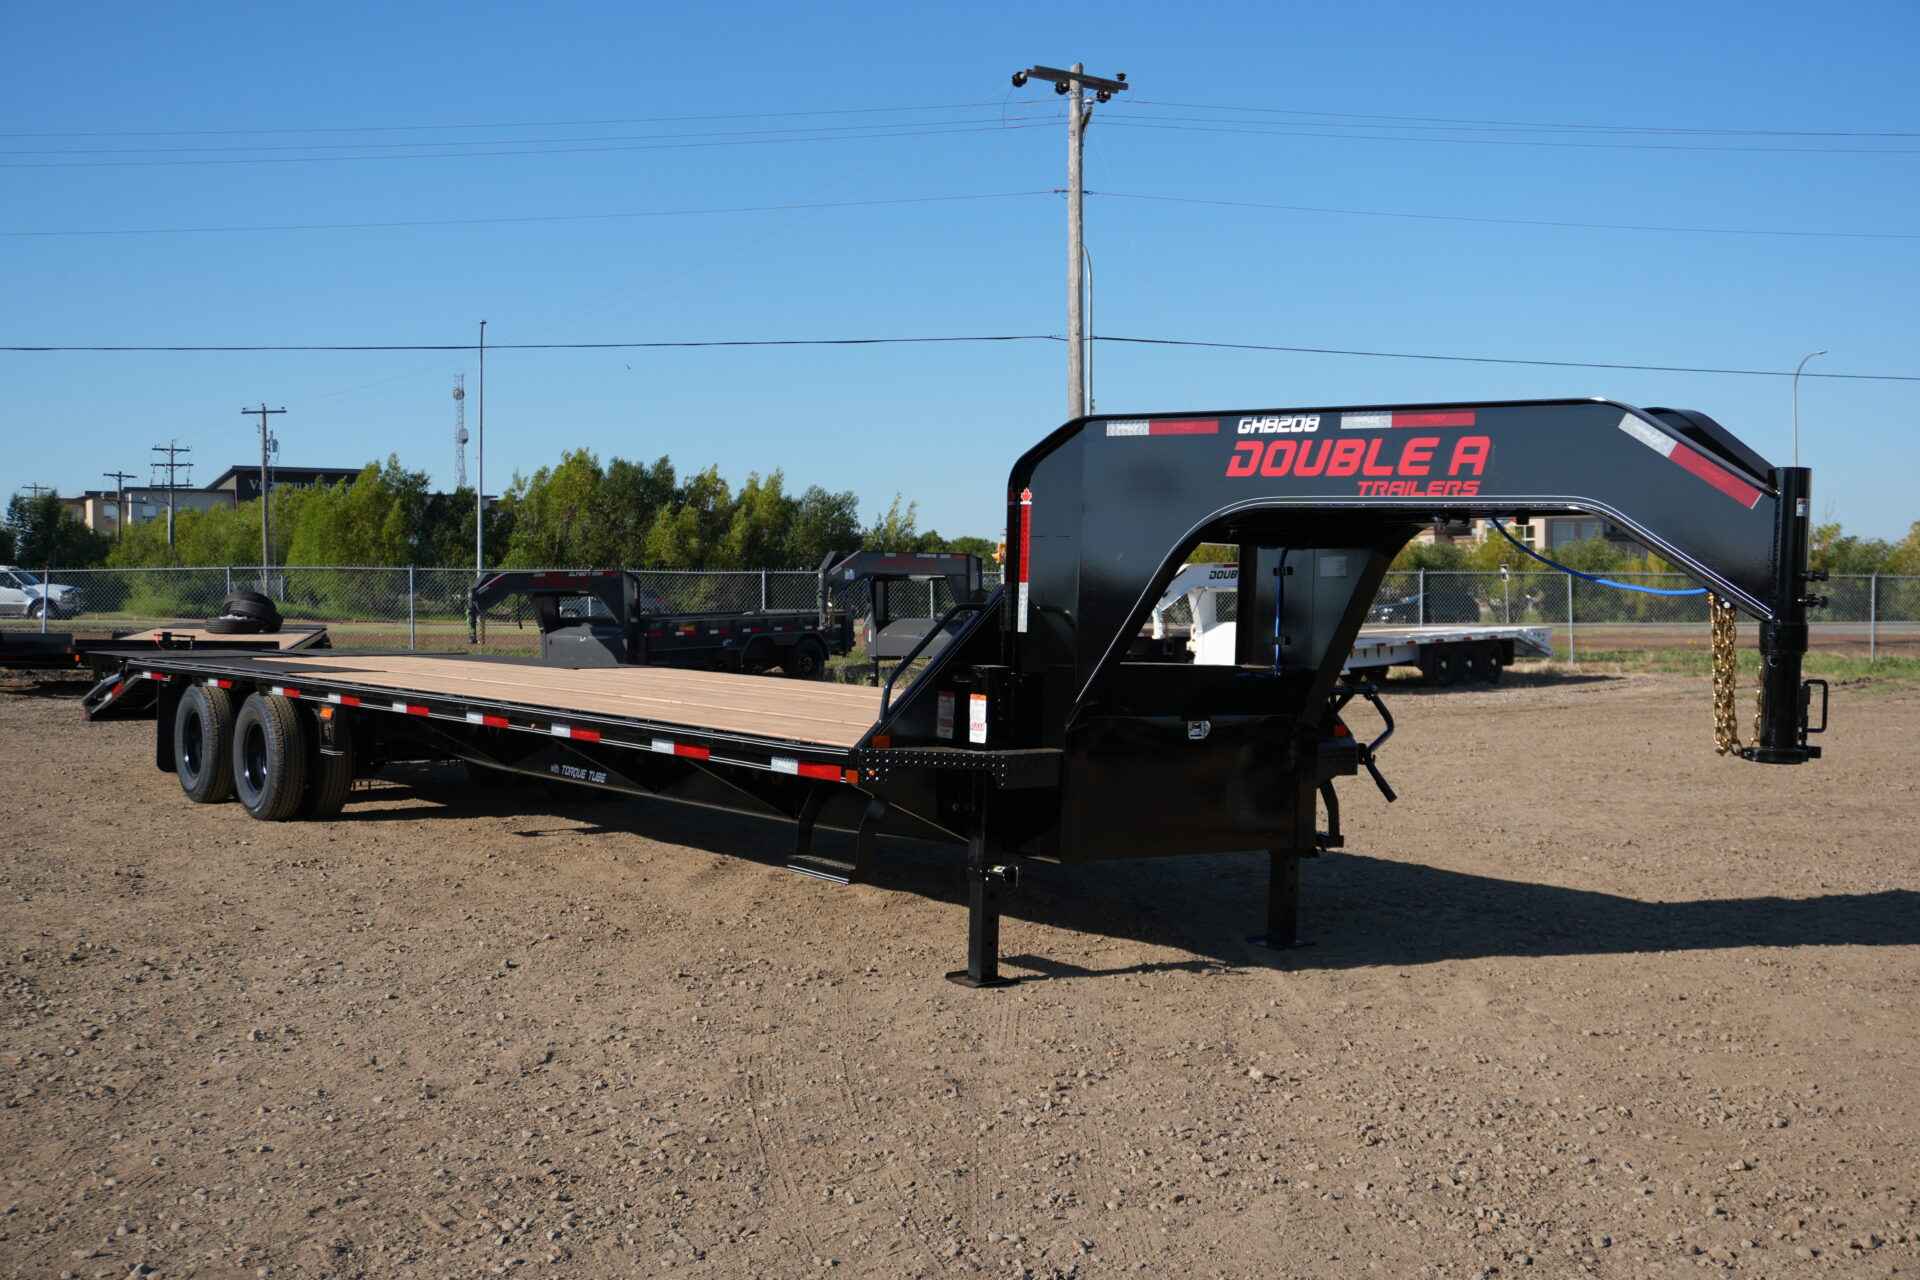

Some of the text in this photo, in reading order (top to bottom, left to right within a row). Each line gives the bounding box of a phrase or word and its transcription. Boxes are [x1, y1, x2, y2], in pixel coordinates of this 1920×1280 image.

[1225, 436, 1491, 478] DOUBLE A
[1357, 480, 1481, 497] TRAILERS
[561, 764, 588, 780] TORQUE
[588, 769, 608, 783] TUBE
